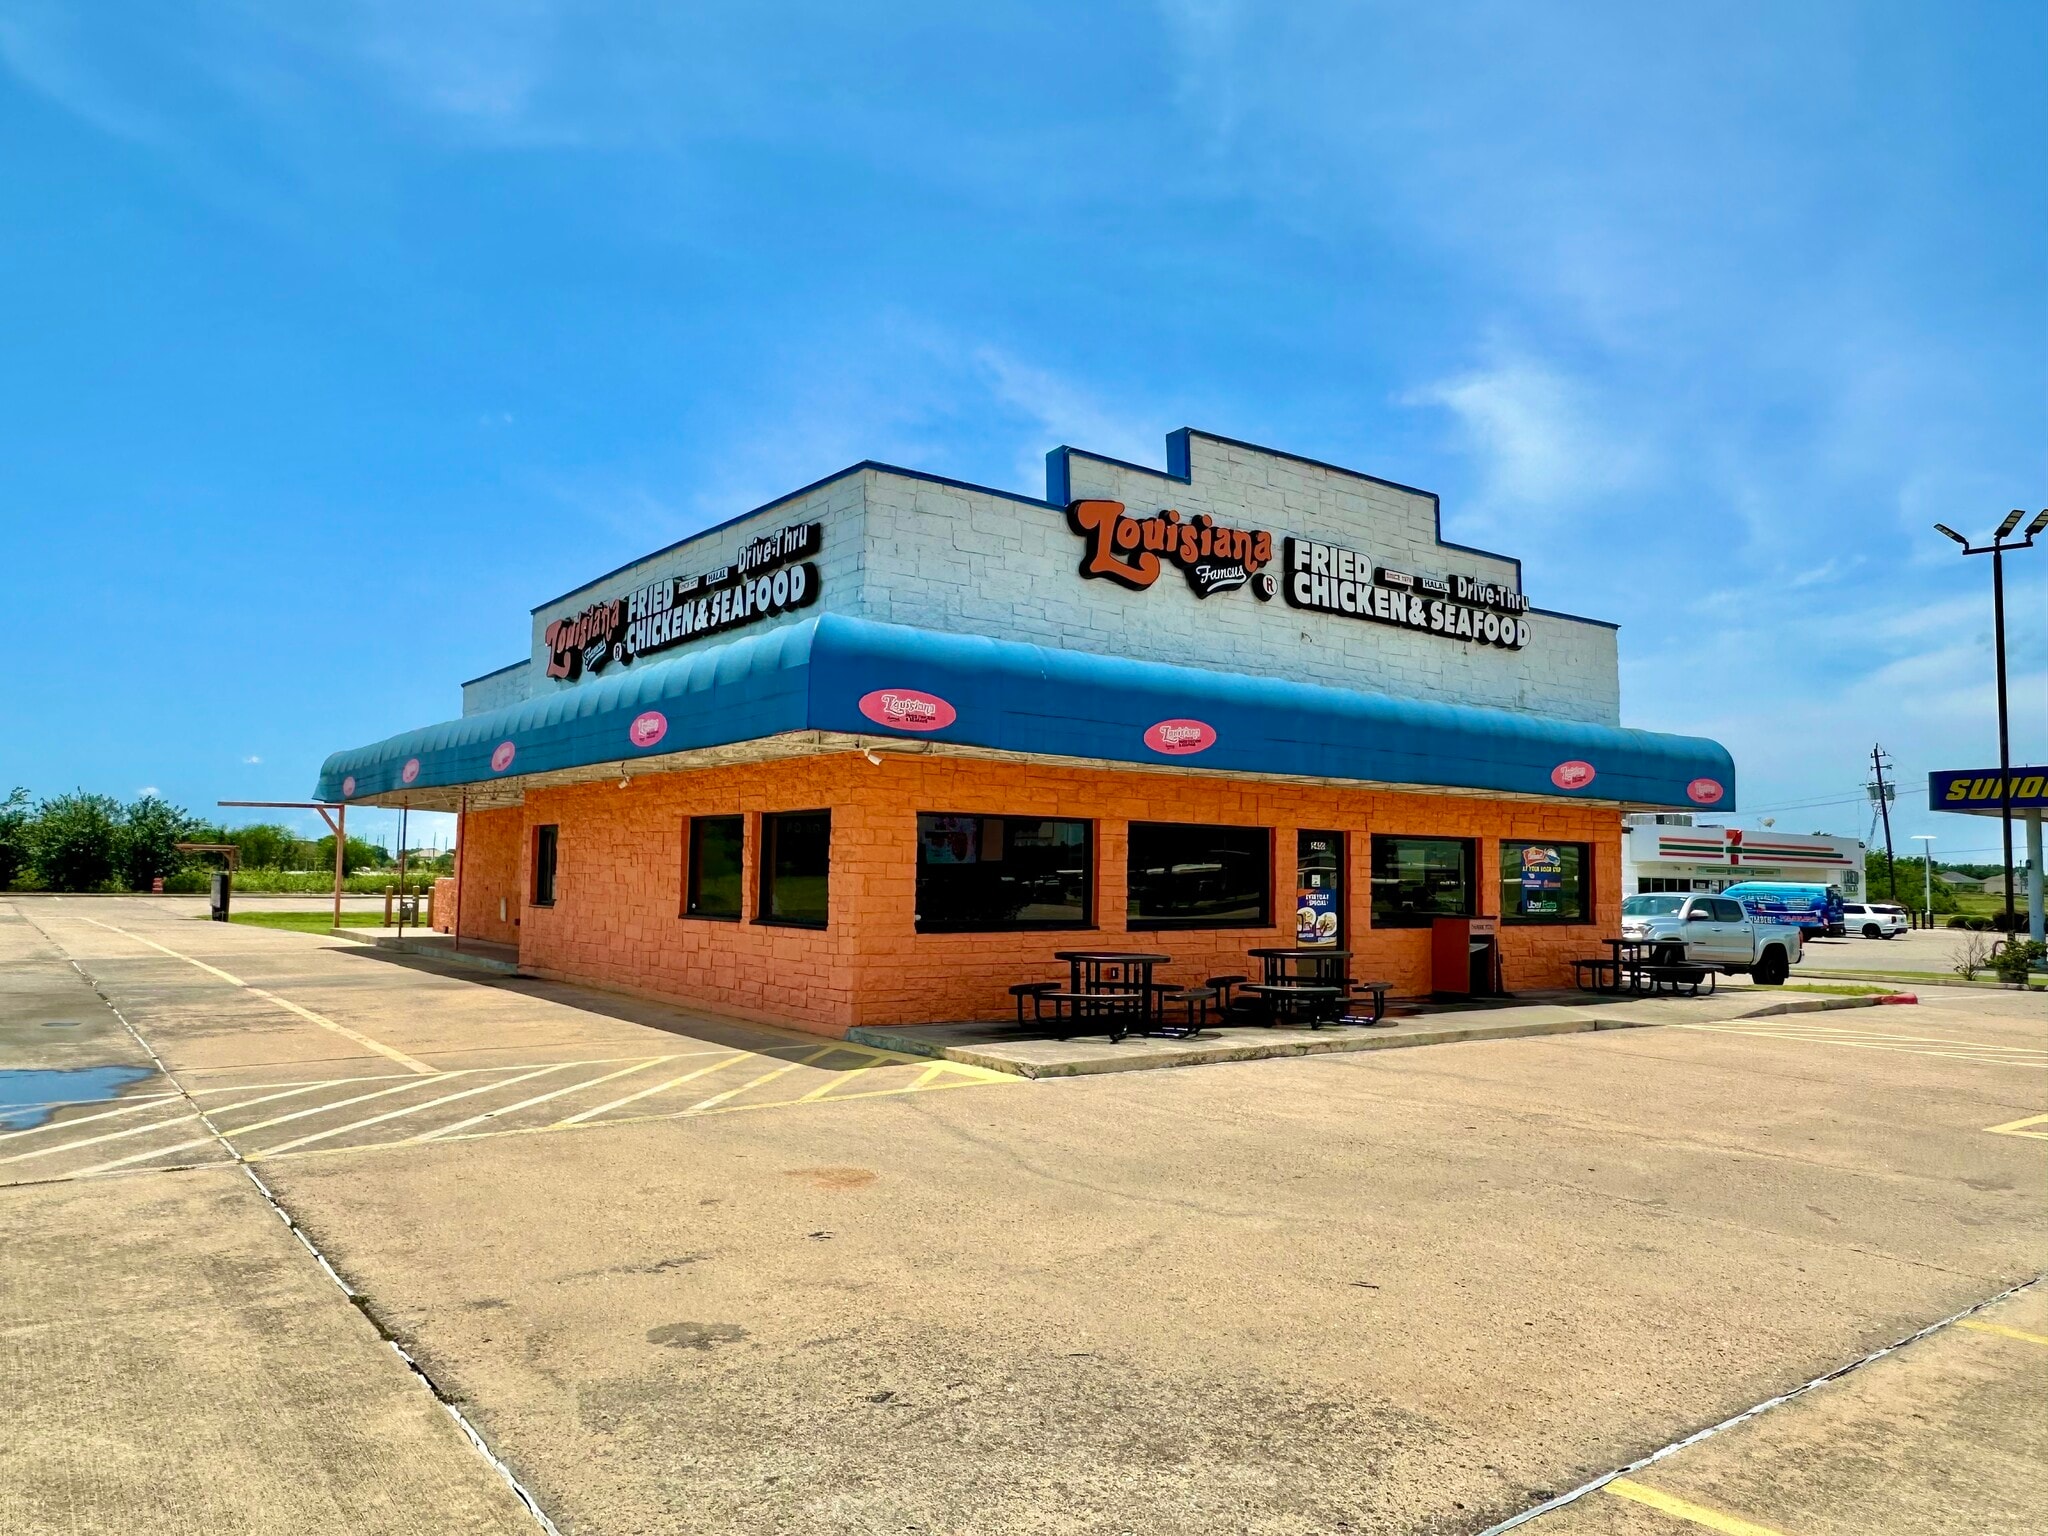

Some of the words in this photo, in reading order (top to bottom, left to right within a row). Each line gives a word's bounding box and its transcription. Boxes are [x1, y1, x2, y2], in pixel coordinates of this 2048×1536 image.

[738, 524, 807, 574] Drive-Thru
[1077, 501, 1272, 585] Louisiana
[1294, 539, 1372, 584] FRIED
[708, 569, 726, 583] HALAL
[1196, 564, 1246, 586] Famous
[1424, 579, 1447, 591] HALAL
[1457, 576, 1529, 611] Drive-Thru
[626, 600, 696, 654] CHICKEN
[711, 565, 806, 627] SEAFOOD
[627, 578, 674, 623] FRIED
[1294, 571, 1407, 622] CHICKEN
[1430, 602, 1531, 647] SEAFOOD
[545, 599, 619, 679] Louisiana
[1945, 777, 2048, 800] SUNO
